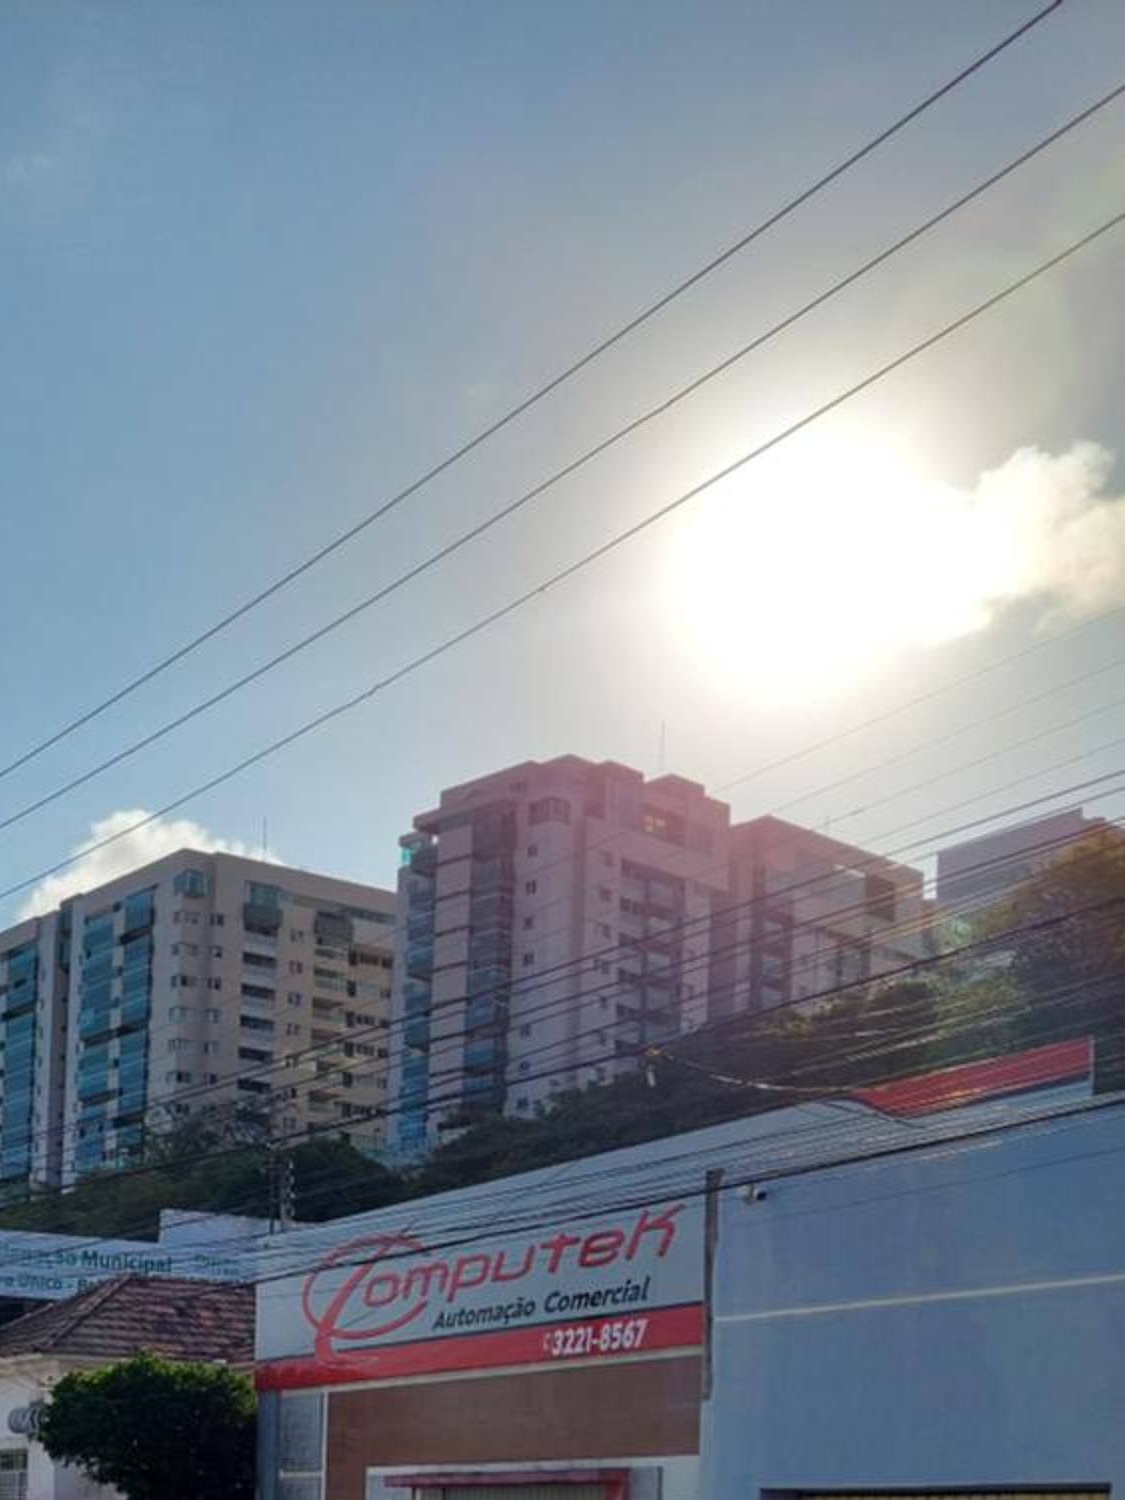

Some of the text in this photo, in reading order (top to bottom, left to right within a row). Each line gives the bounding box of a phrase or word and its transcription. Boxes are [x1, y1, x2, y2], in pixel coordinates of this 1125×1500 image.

[81, 1250, 173, 1276] Municipal
[431, 1275, 650, 1330] Automação Comercial
[551, 1319, 649, 1356] 3221-8567
